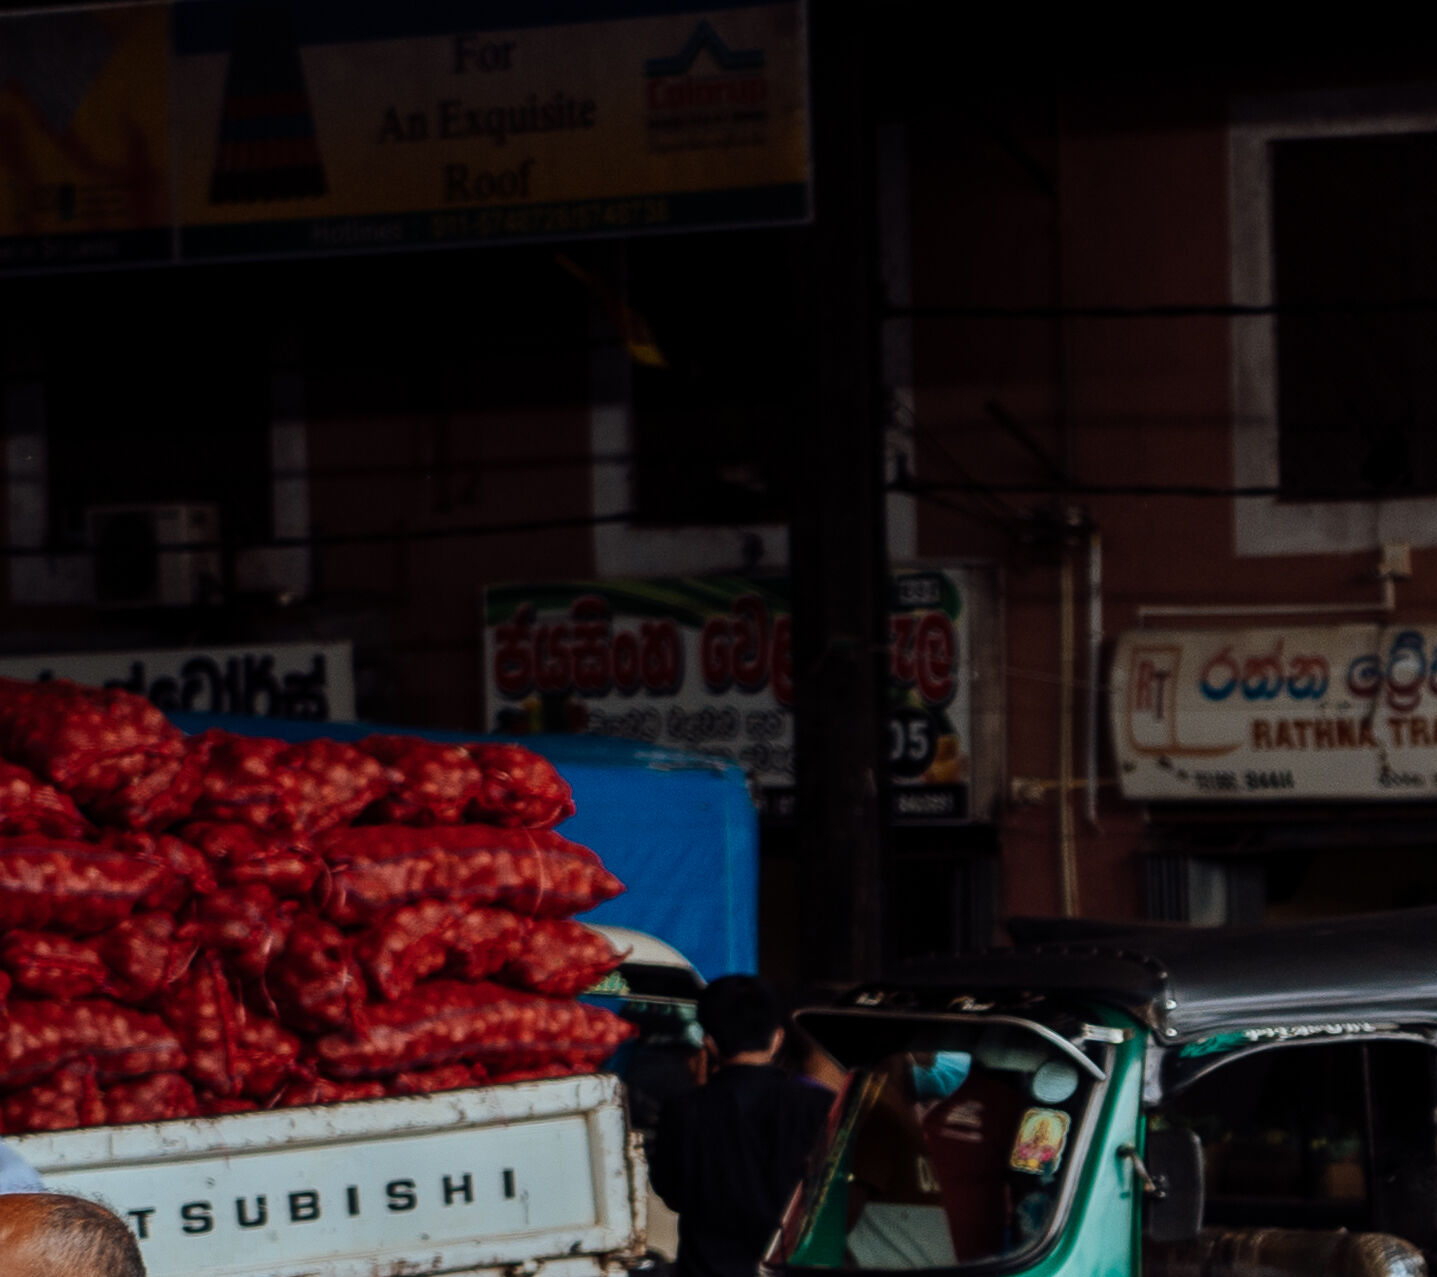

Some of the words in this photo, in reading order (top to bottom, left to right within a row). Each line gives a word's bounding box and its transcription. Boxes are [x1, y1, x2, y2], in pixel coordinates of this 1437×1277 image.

[454, 34, 515, 74] For
[378, 108, 430, 146] An
[440, 92, 597, 146] Exquisite
[446, 157, 535, 204] Roof
[1199, 637, 1330, 702] රත්න
[1252, 716, 1378, 752] RATHNA
[127, 1168, 518, 1240] TSUBISHI
